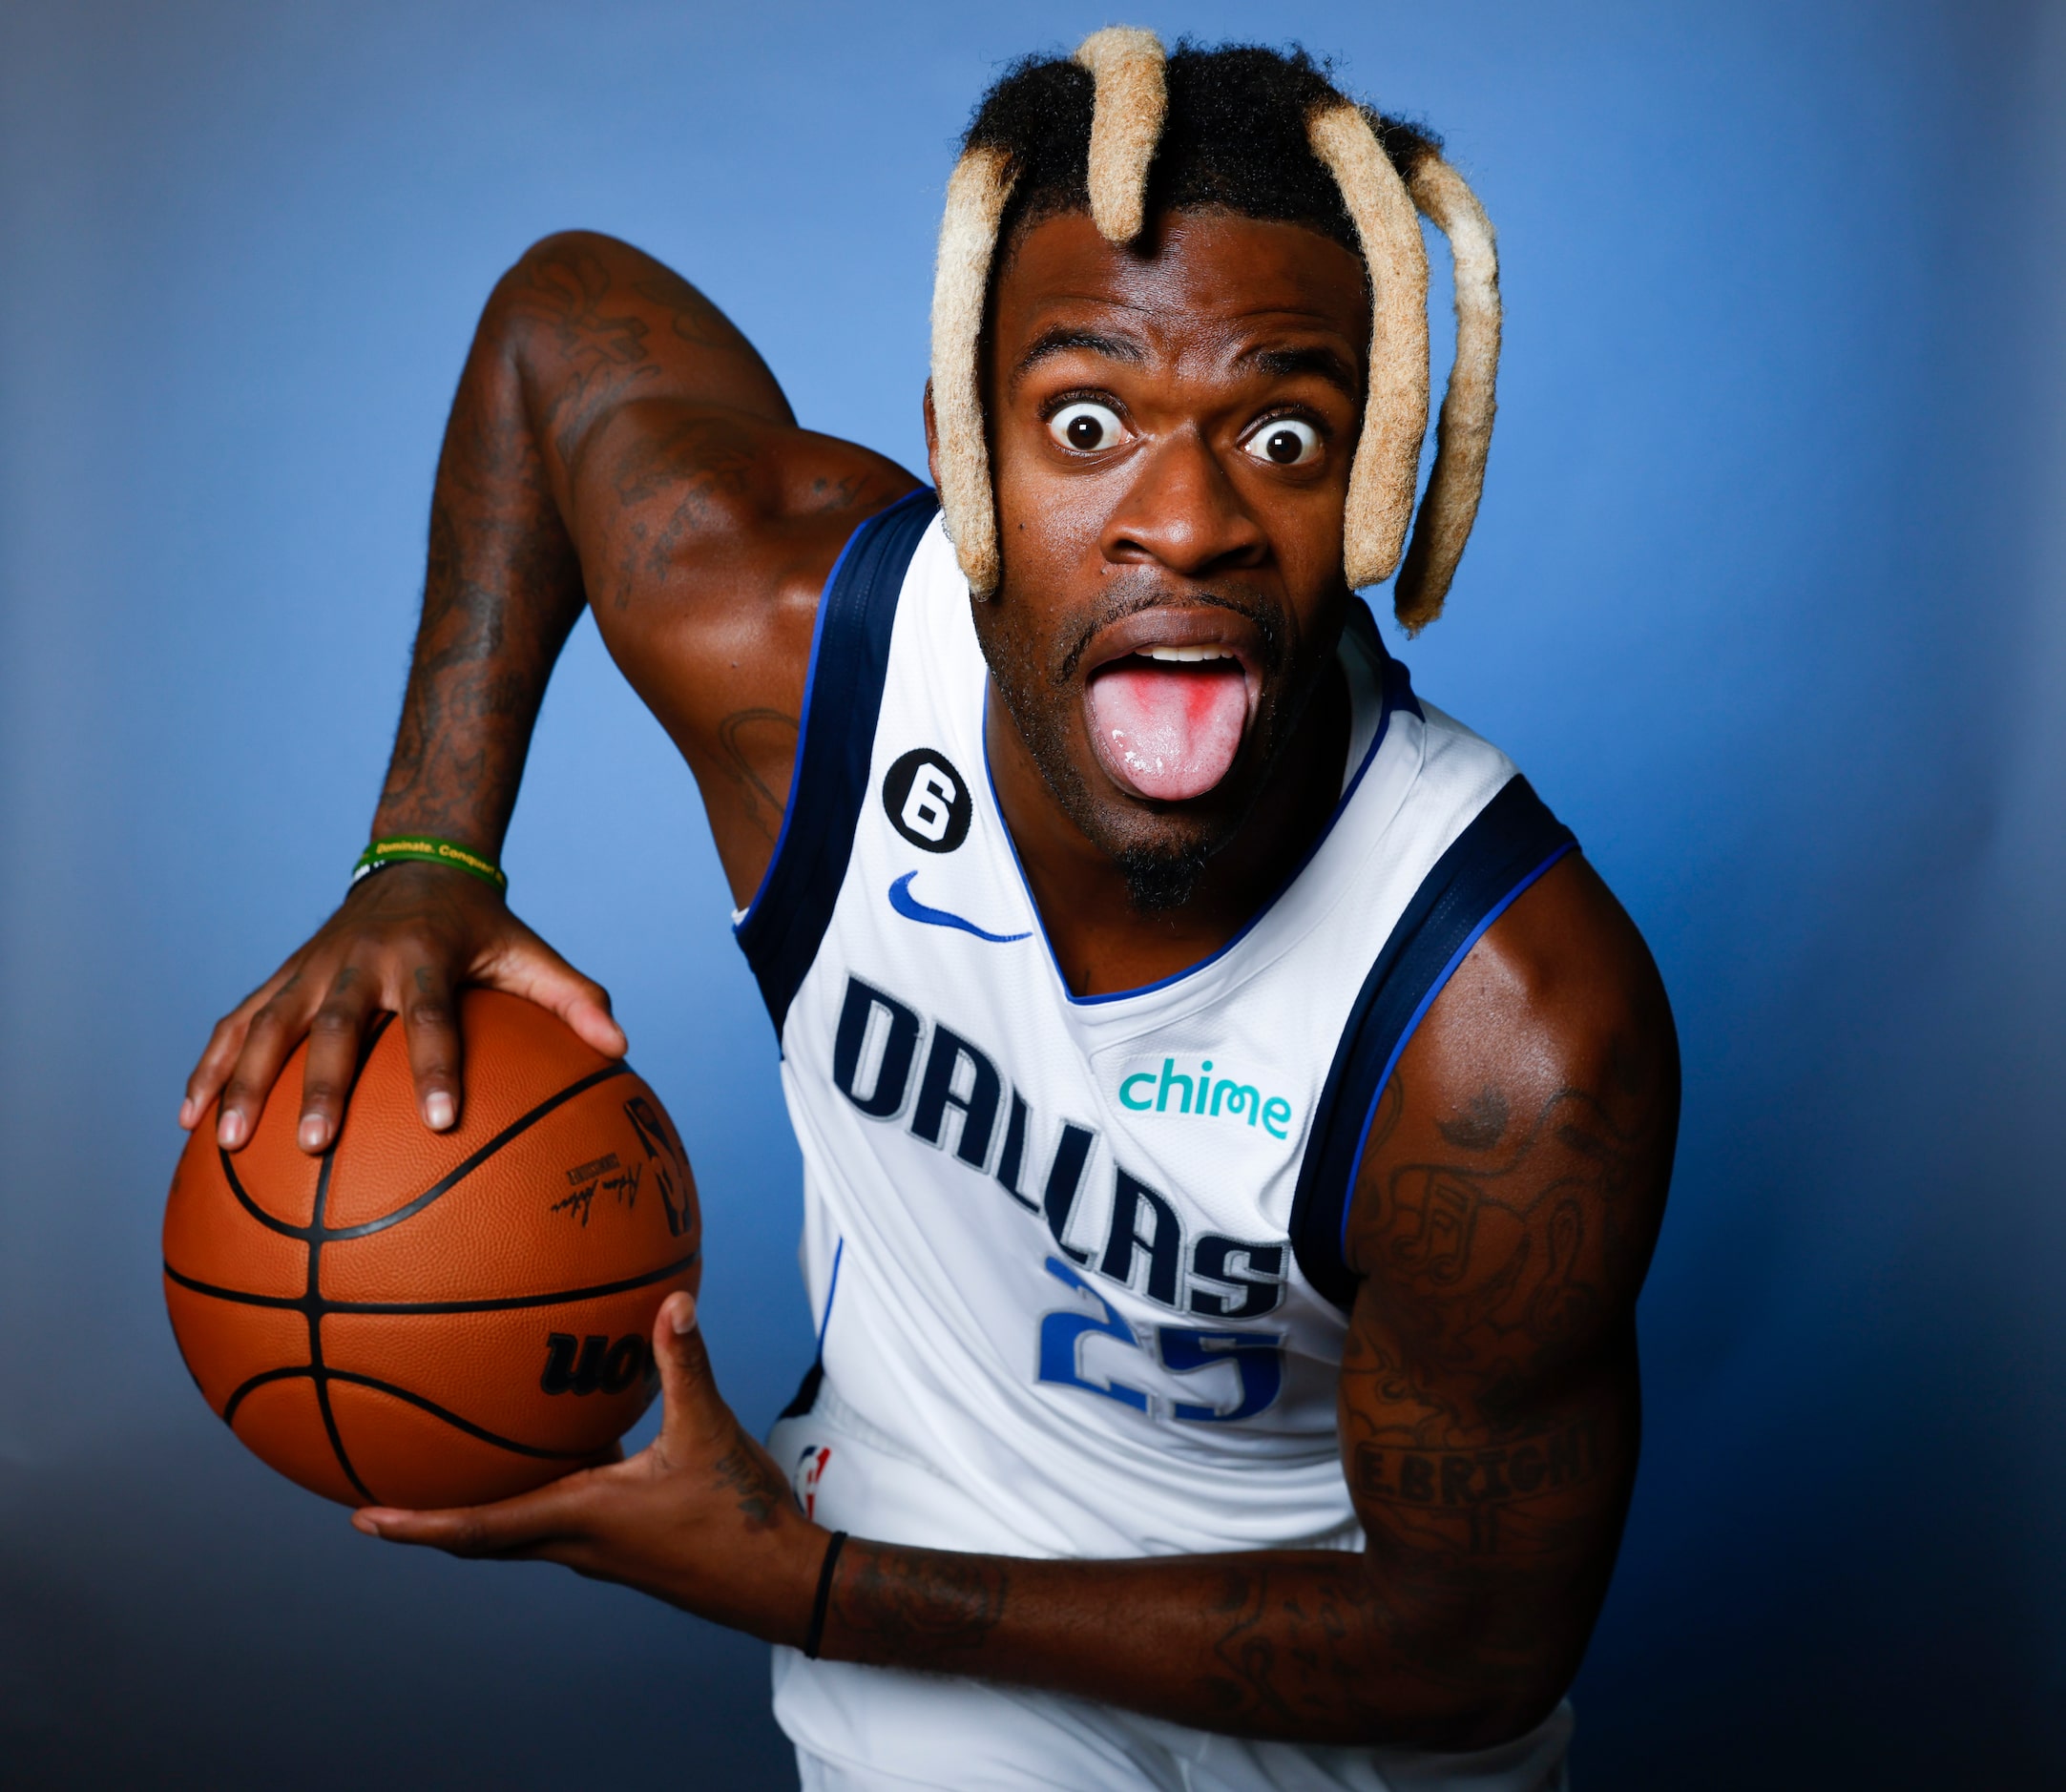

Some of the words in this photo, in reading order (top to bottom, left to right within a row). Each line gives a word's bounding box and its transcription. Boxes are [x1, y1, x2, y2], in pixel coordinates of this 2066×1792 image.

[900, 761, 957, 843] 6
[833, 971, 1290, 1321] DALLAS
[1118, 1057, 1291, 1140] chime
[1035, 1255, 1284, 1423] 25
